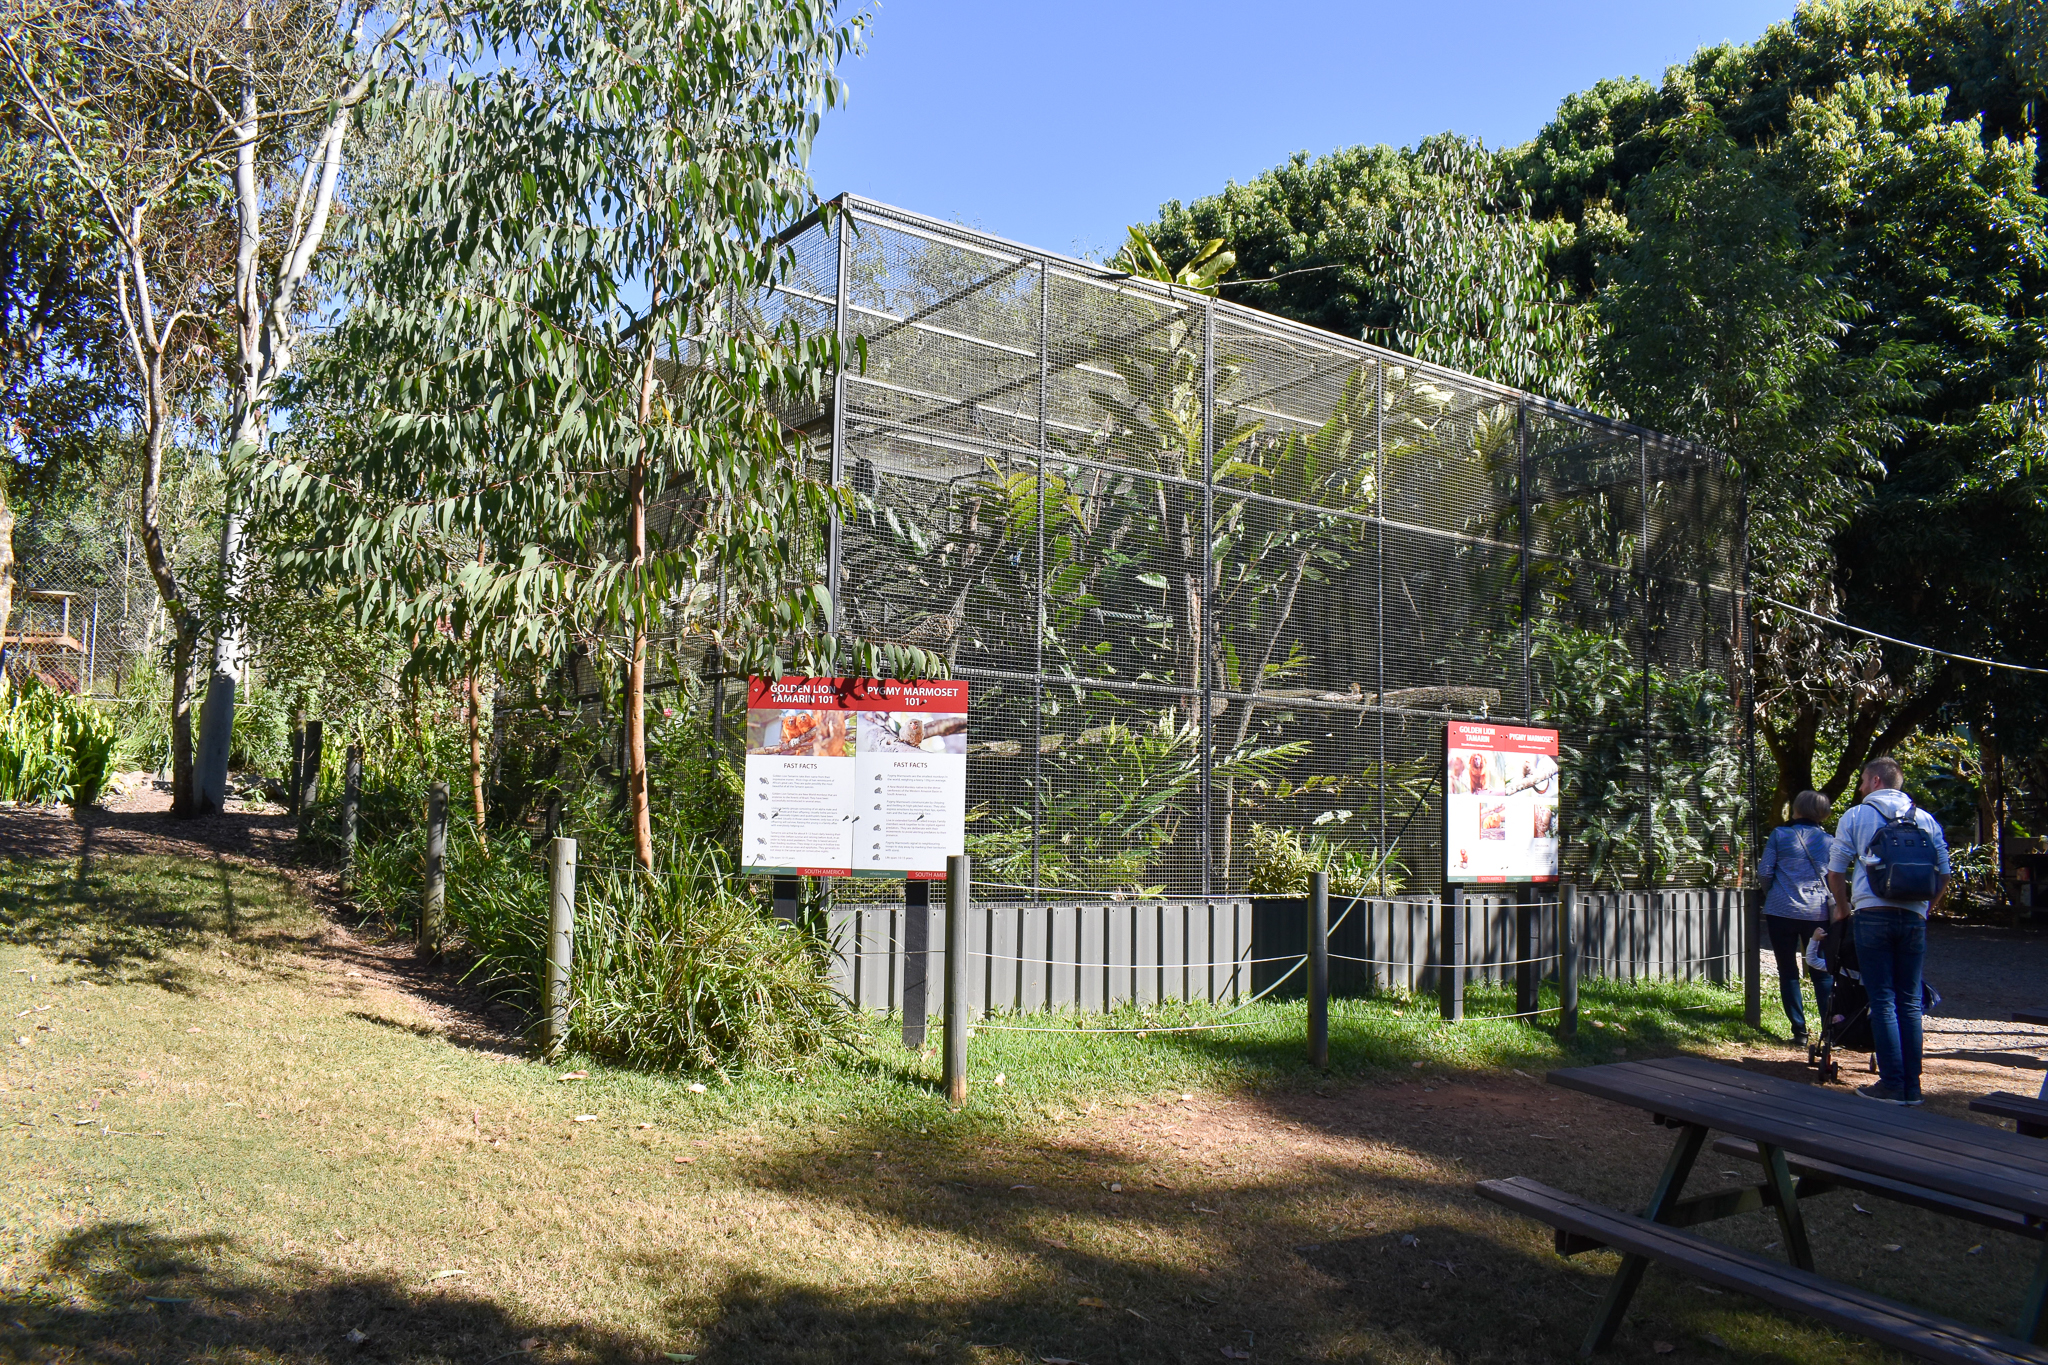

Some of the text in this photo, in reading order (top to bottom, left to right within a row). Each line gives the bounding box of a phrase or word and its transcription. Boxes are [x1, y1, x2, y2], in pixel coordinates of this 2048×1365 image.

[770, 684, 836, 694] GOLDEN LION
[867, 686, 959, 697] PYGMY MARMOSET
[772, 693, 833, 704] TAMARIN 101
[905, 697, 920, 706] 101
[1459, 725, 1496, 736] GOLDEN LION
[1465, 734, 1490, 743] TAMARIN
[1509, 733, 1526, 742] PYGMY
